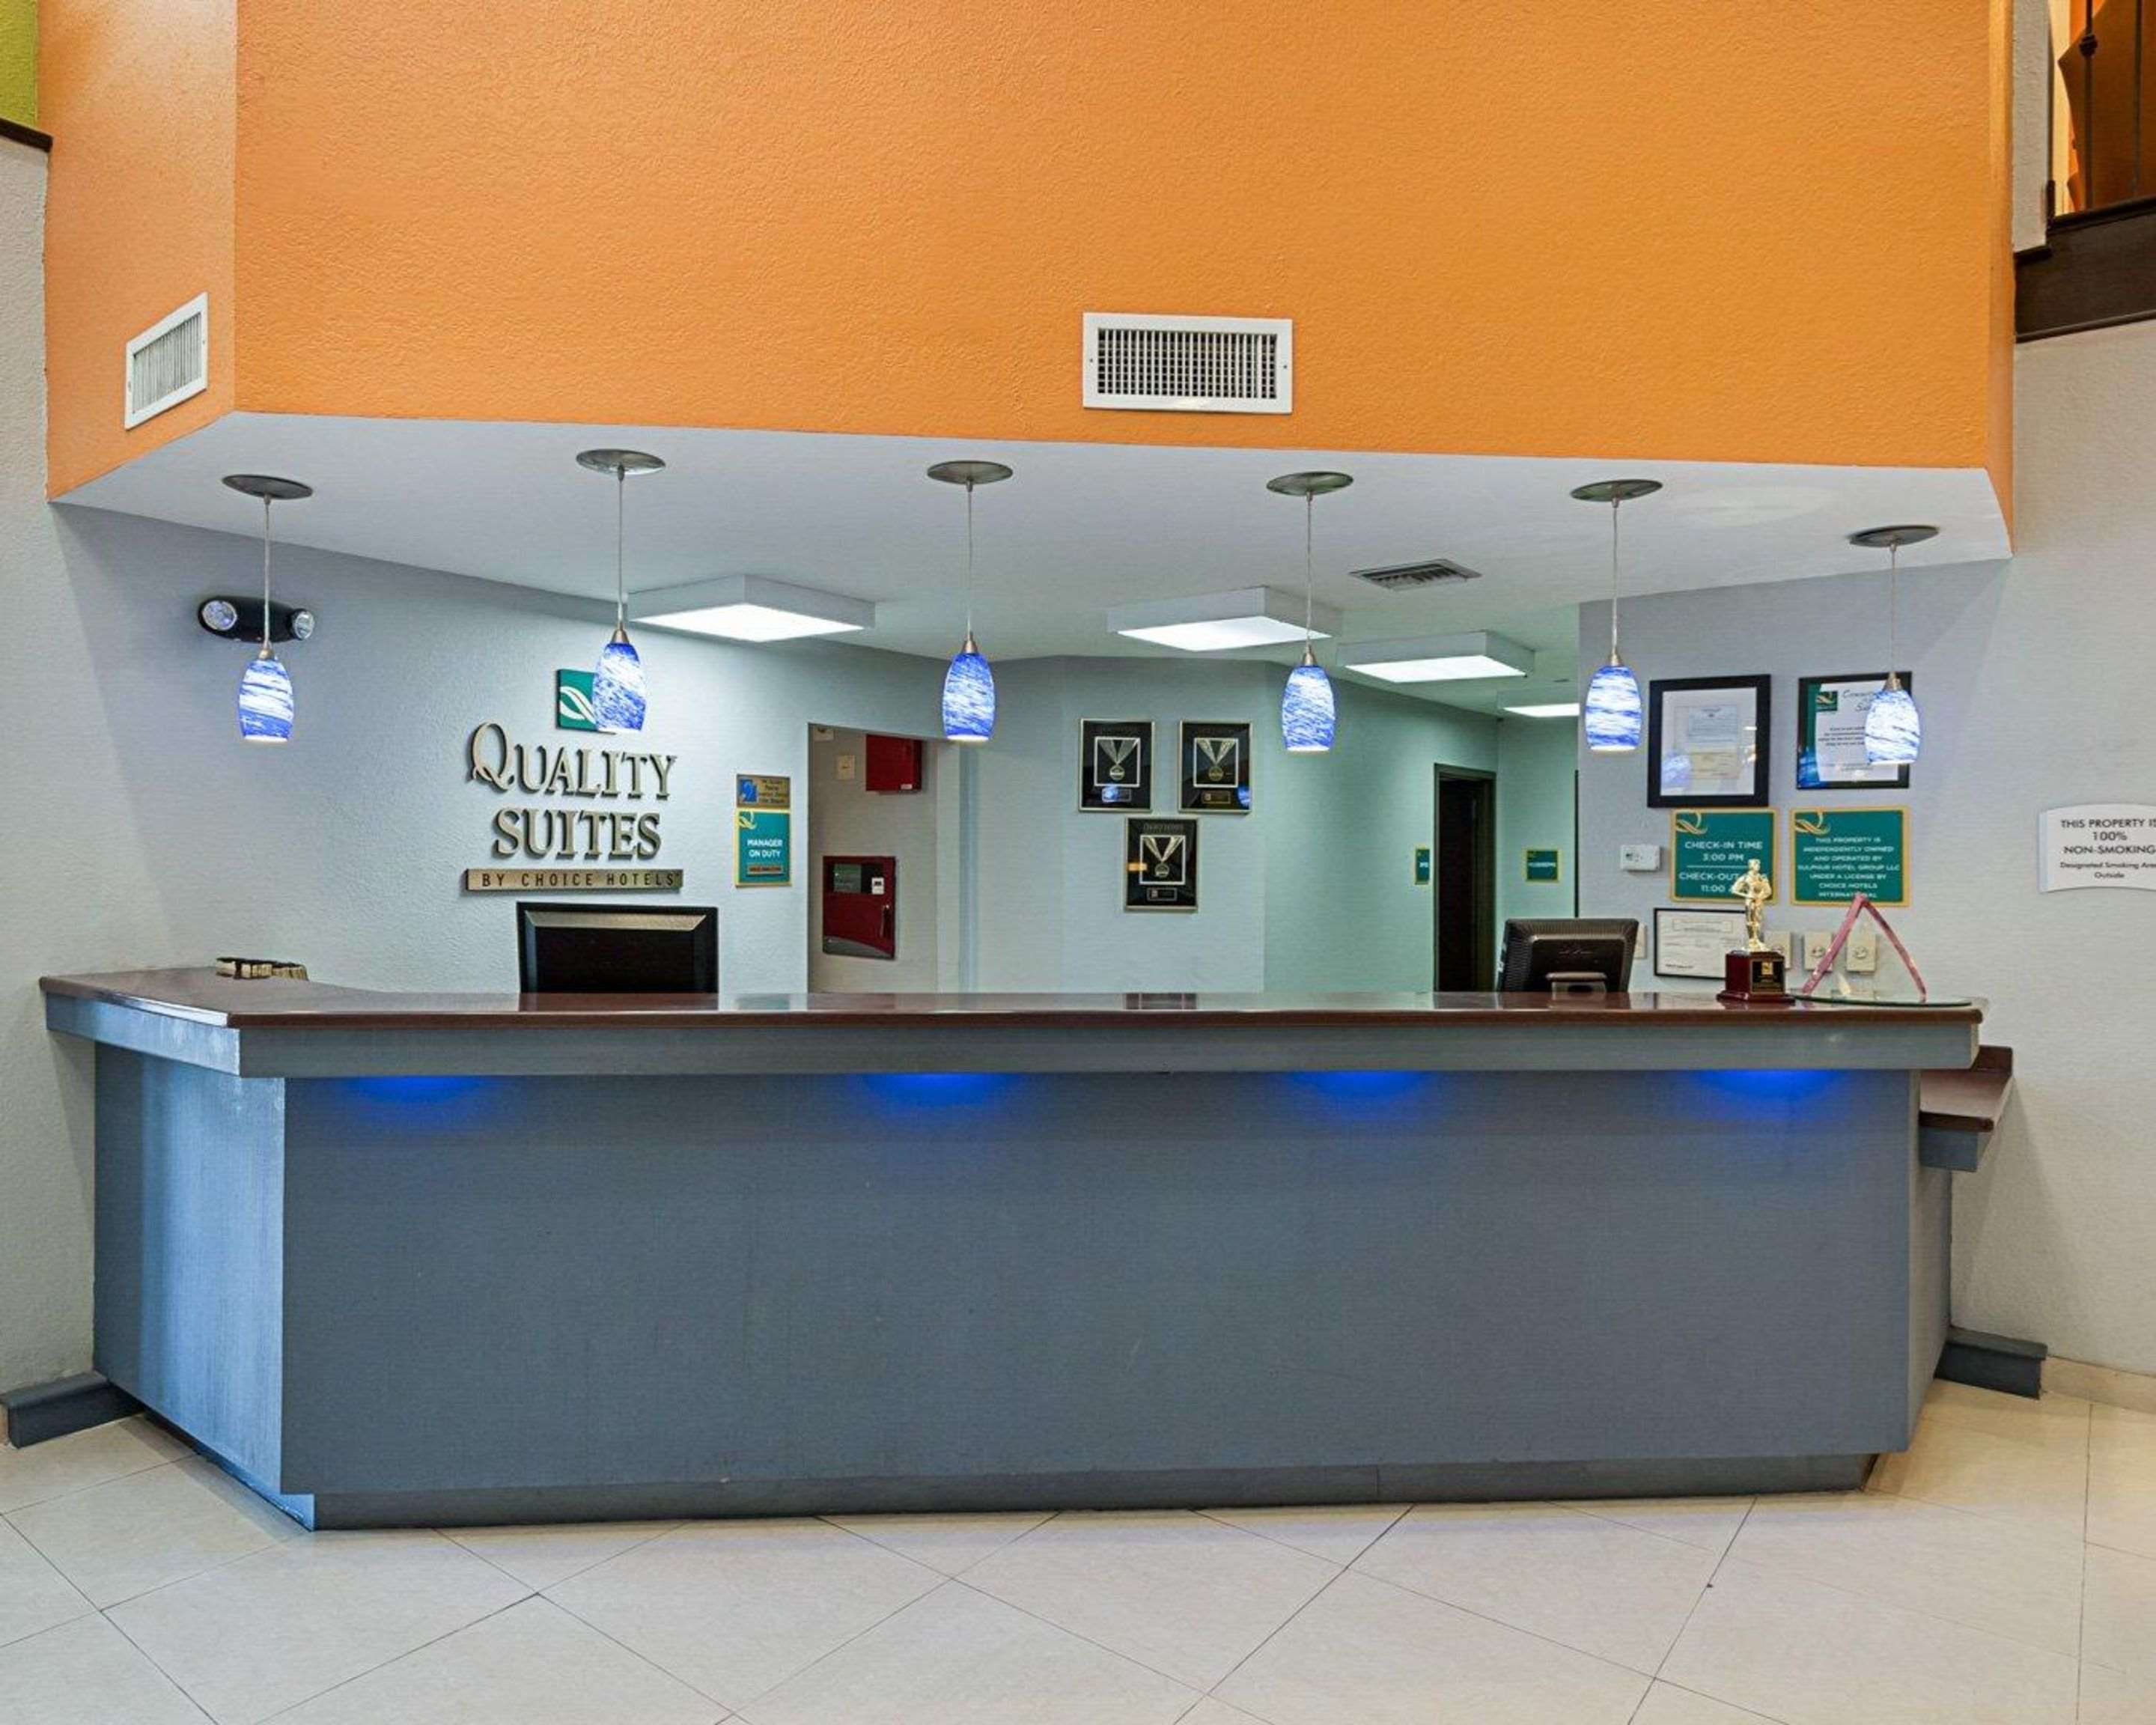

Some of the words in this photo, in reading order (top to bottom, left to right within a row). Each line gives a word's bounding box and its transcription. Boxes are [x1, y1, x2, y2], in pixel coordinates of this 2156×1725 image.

[468, 722, 677, 800] QUALITY
[2061, 819, 2085, 828] THIS
[2089, 818, 2146, 828] PROPERTY
[492, 807, 662, 860] SUITES
[2092, 831, 2128, 841] 100%
[747, 839, 783, 848] MANAGER
[1684, 841, 1735, 849] CHECK-IN
[1738, 842, 1763, 850] TIME
[749, 849, 761, 857] ON
[761, 849, 781, 858] DUTY
[2064, 845, 2156, 854] NON-SMOKING
[1702, 853, 1726, 861] 3:00
[481, 873, 505, 886] BY
[521, 873, 593, 886] CHOICE
[606, 873, 674, 886] HOTELS
[1678, 872, 1740, 881] CHECK-OUT
[2094, 871, 2125, 879] Outside
[1700, 884, 1726, 893] 11:00
